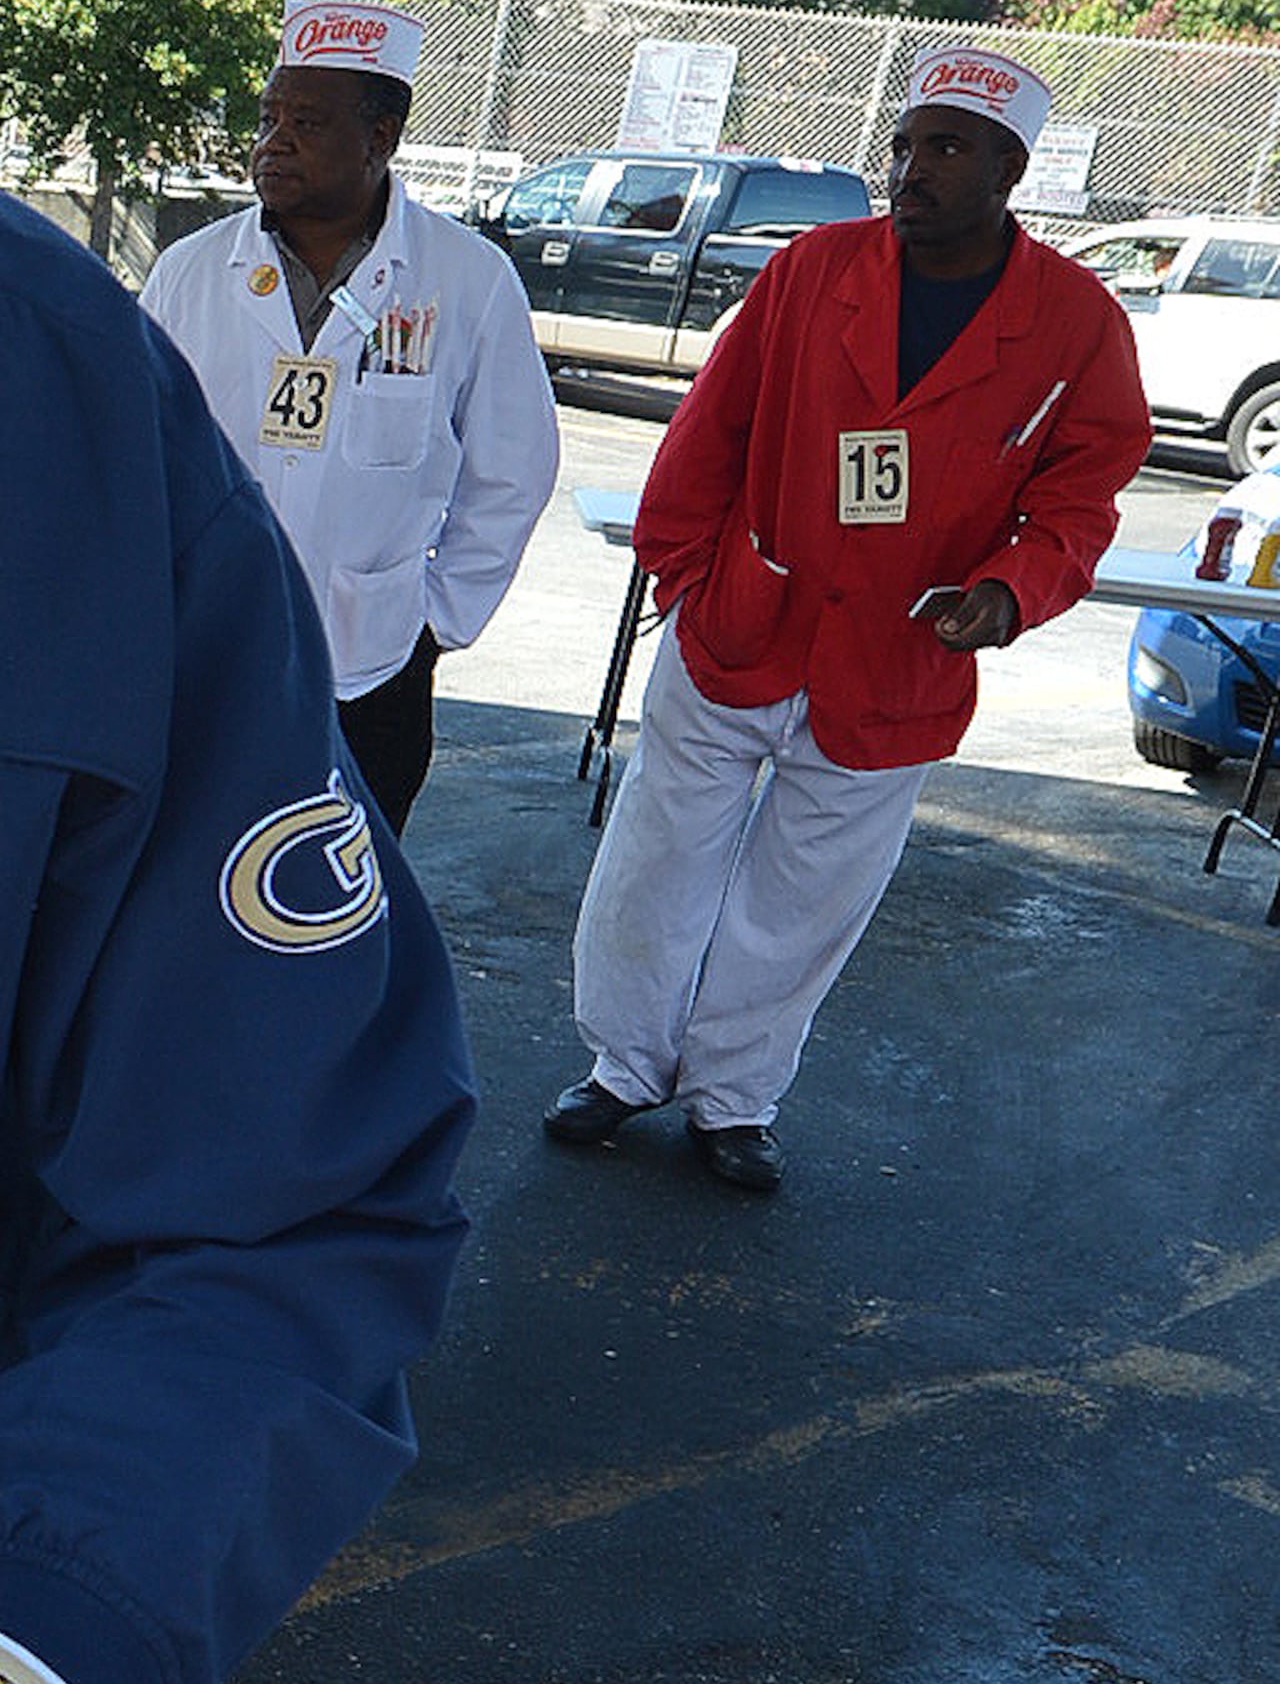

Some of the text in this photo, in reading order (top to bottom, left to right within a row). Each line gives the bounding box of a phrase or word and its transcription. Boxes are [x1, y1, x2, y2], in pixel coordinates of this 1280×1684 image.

[295, 19, 388, 53] Orange
[920, 62, 1020, 94] Orange
[270, 369, 327, 429] 43
[848, 444, 901, 500] 15
